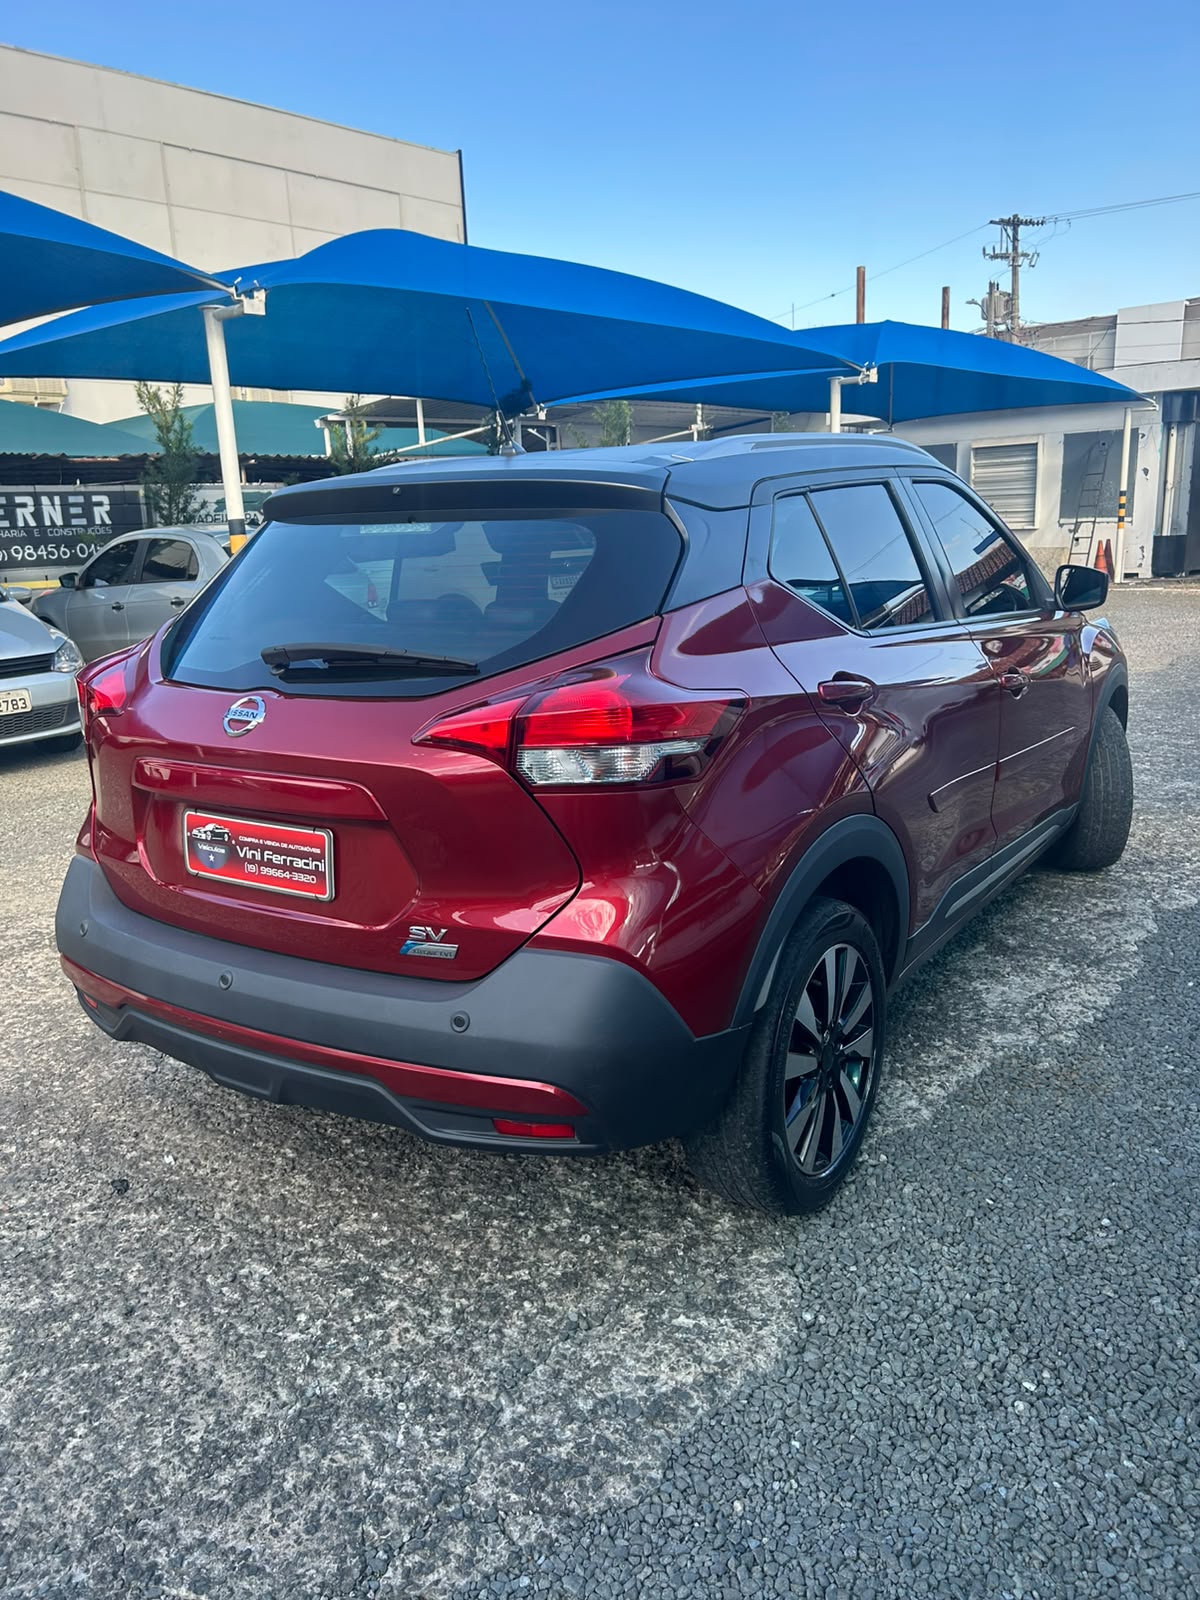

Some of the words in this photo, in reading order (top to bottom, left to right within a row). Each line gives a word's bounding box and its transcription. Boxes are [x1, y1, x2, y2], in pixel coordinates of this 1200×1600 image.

[239, 835, 259, 844] COMPRA
[236, 845, 261, 860] Vini
[264, 850, 325, 872] Ferracini
[244, 861, 259, 875] (19)
[260, 866, 317, 884] 99664-3320
[409, 925, 448, 942] SV
